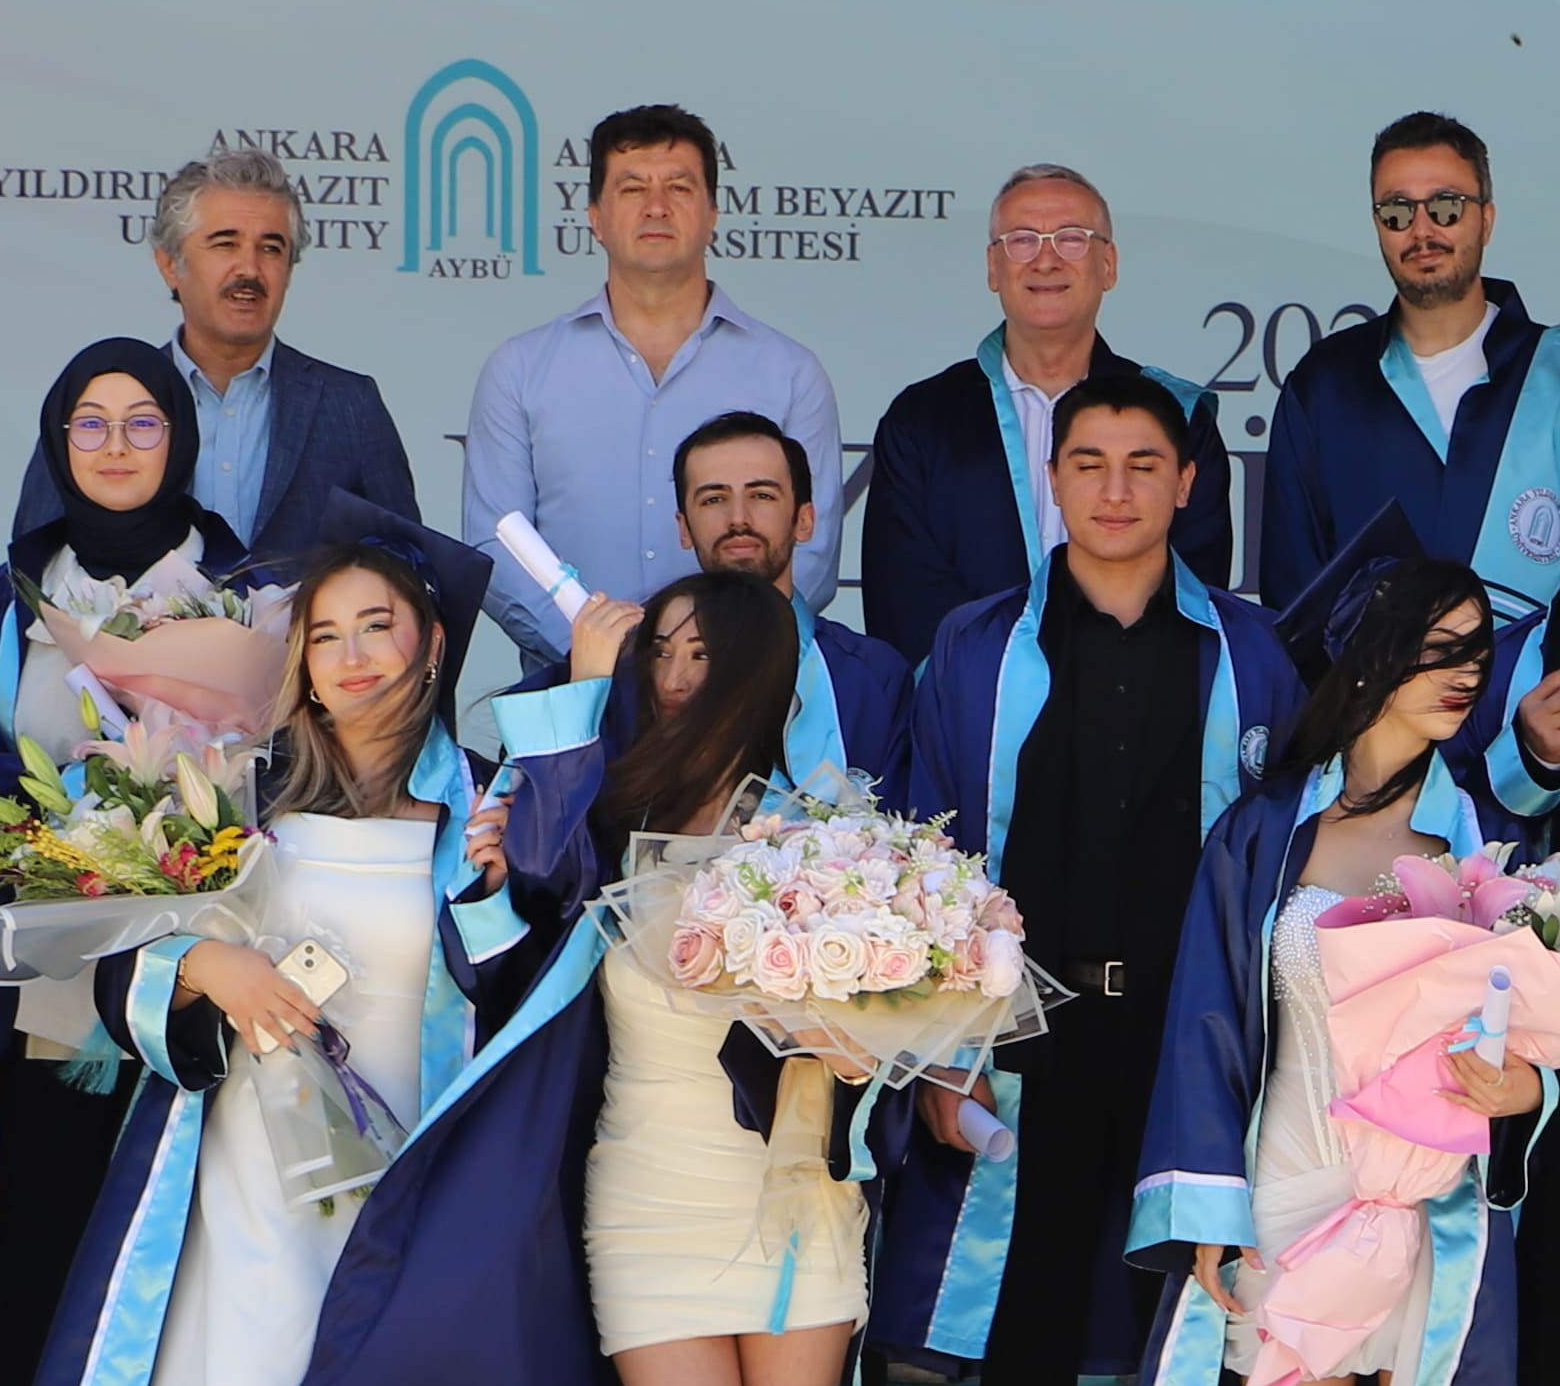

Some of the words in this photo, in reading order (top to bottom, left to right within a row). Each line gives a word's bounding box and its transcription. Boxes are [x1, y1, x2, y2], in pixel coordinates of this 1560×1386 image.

[202, 128, 391, 163] ANKARA
[773, 186, 956, 220] BEYAZIT
[428, 253, 512, 279] AYBÜ
